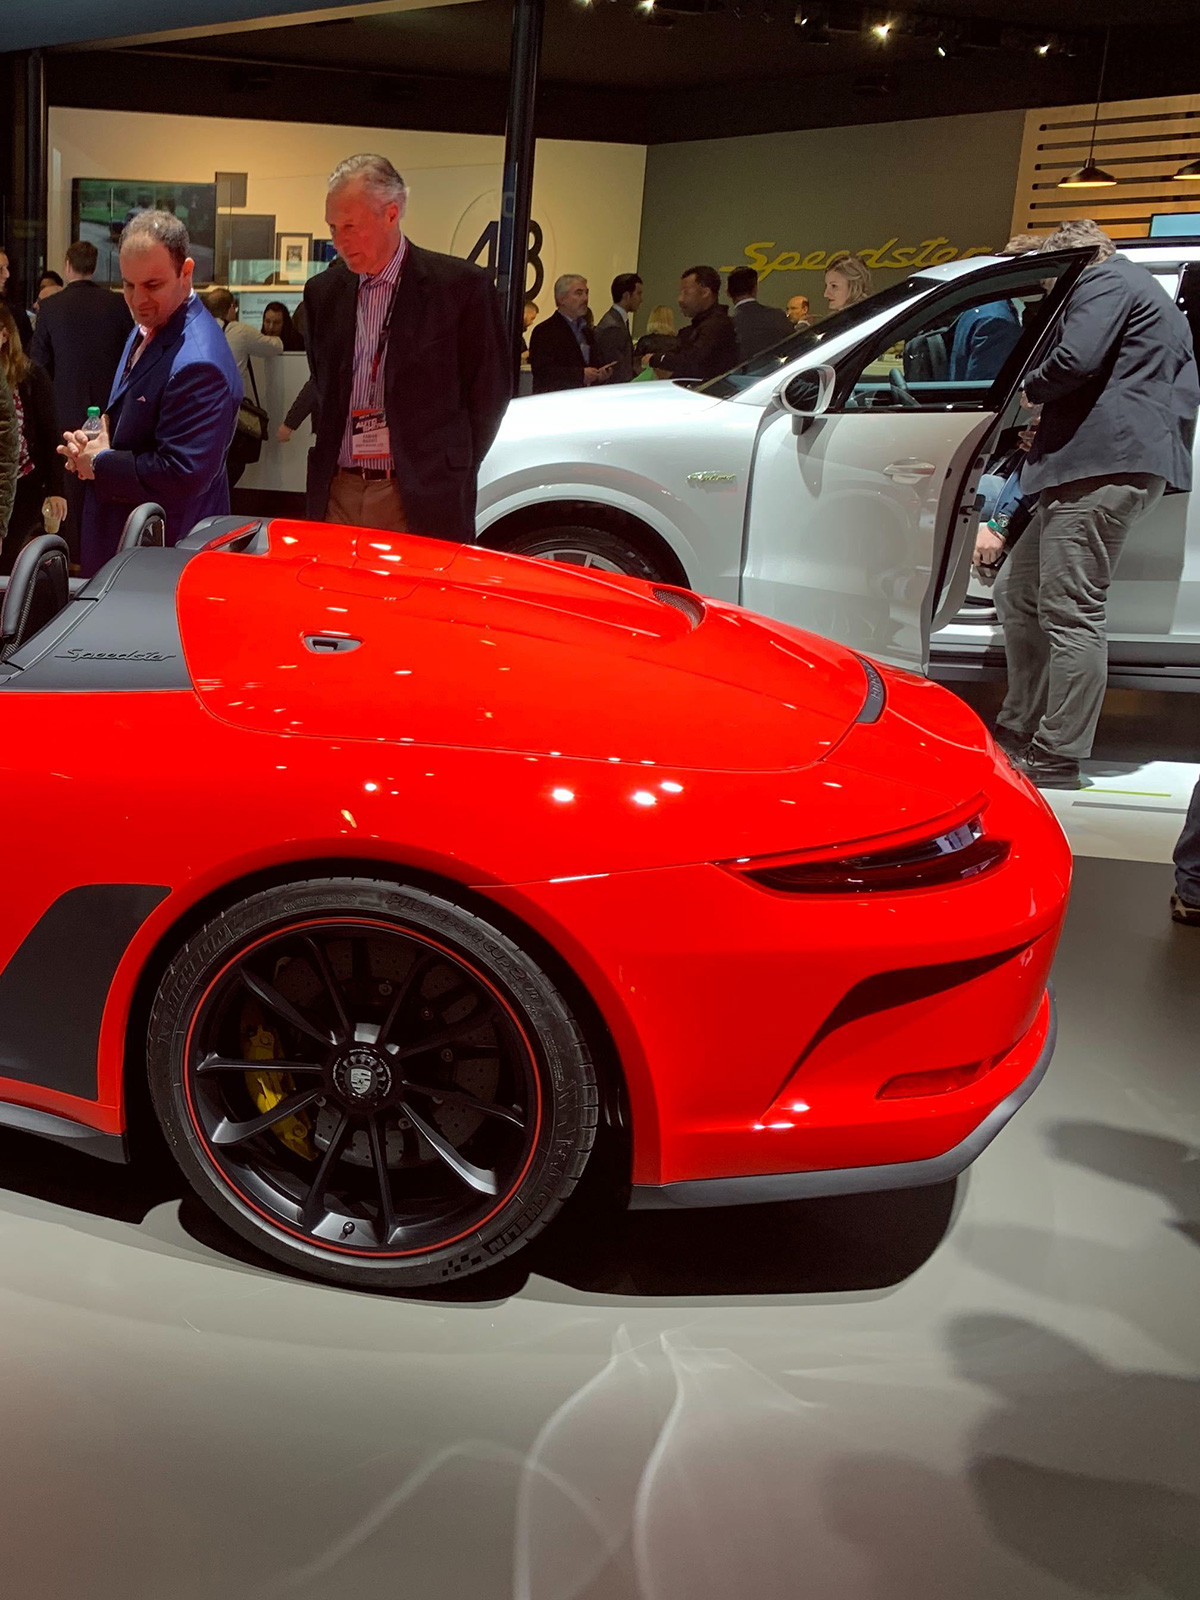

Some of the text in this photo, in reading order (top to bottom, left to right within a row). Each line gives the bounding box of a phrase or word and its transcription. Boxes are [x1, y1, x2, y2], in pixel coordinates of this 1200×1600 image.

[719, 236, 993, 281] Speedster
[54, 649, 177, 662] Speedster
[483, 941, 512, 968] Cup
[508, 966, 528, 981] 2
